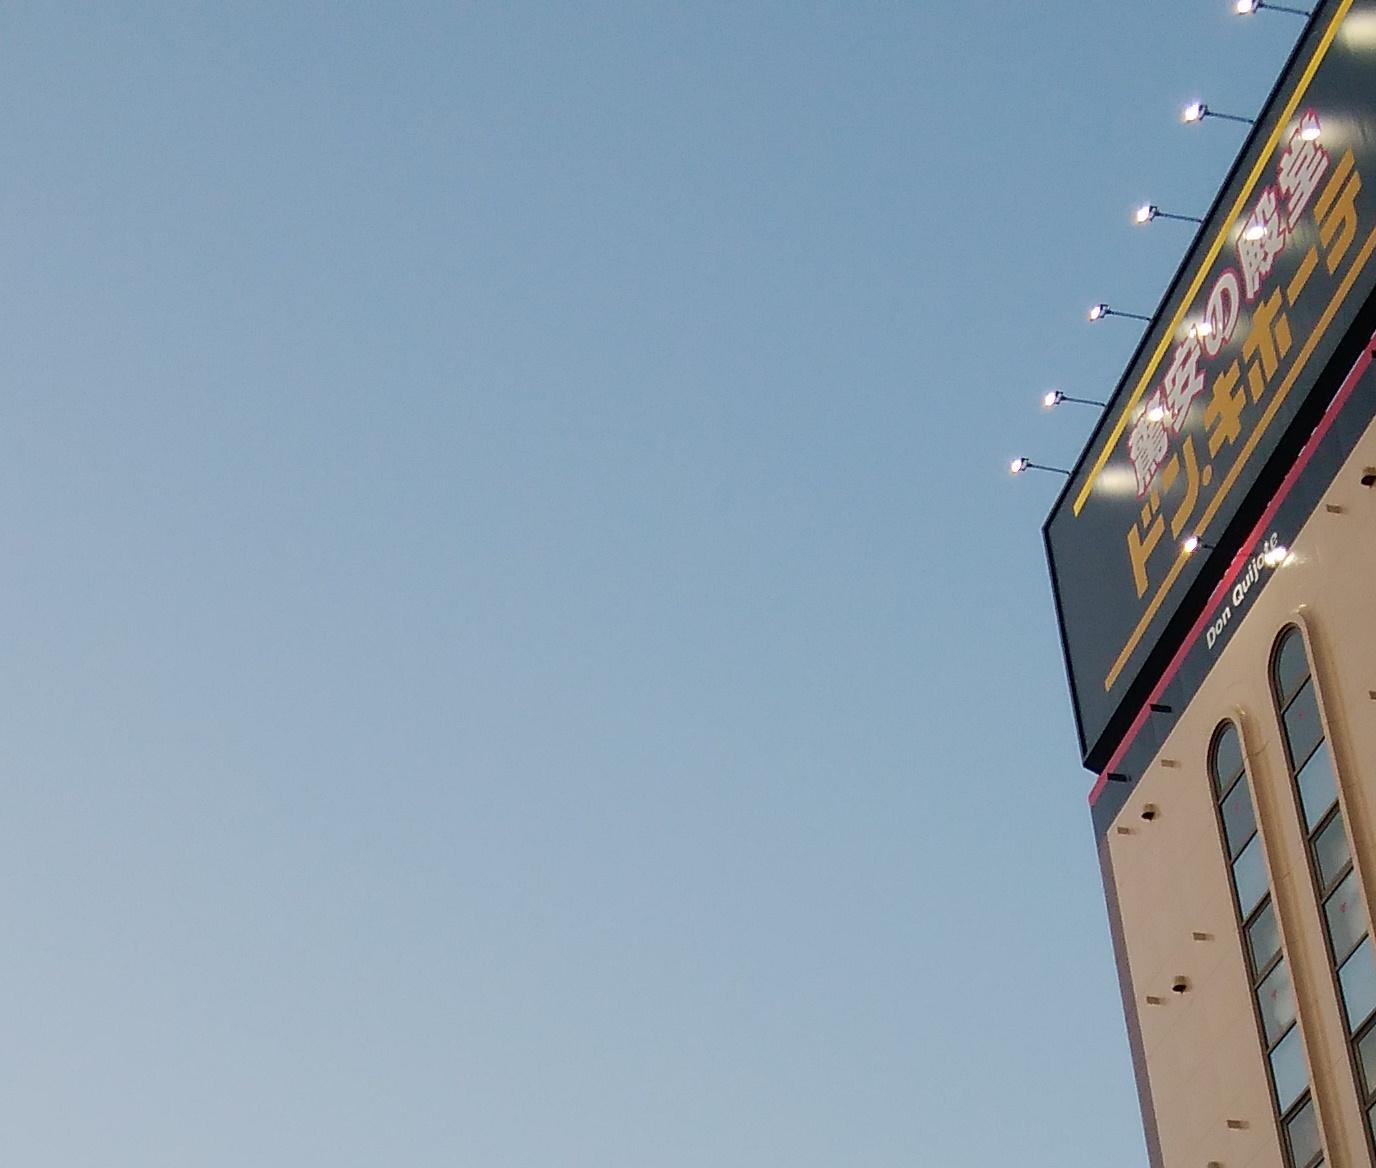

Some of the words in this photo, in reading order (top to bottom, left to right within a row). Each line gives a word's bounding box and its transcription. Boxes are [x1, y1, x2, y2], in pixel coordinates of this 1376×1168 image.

[1127, 109, 1330, 498] 驚安の殿堂
[1206, 607, 1231, 649] Don
